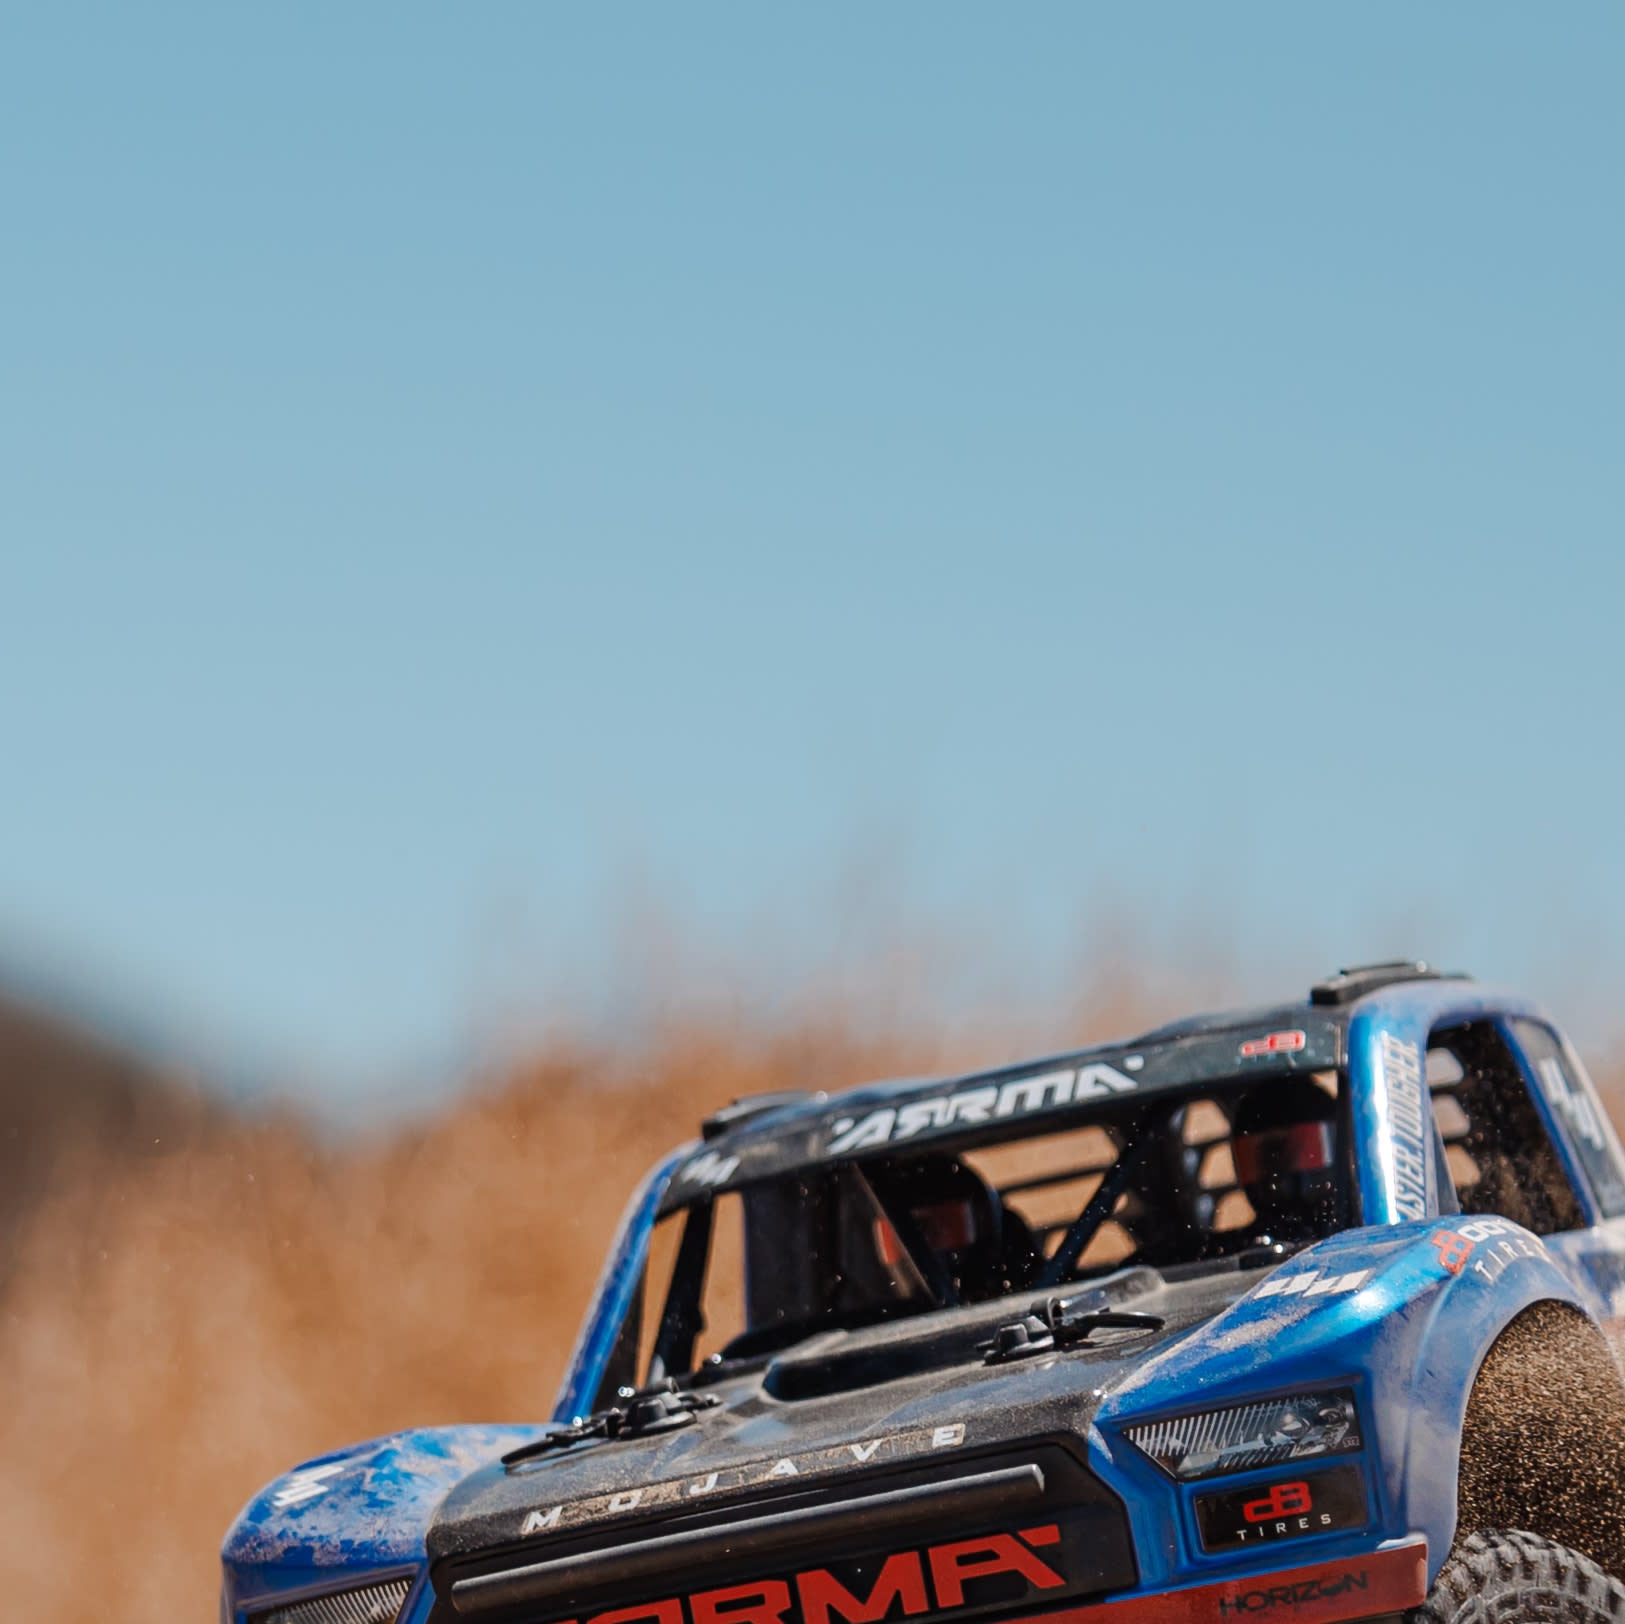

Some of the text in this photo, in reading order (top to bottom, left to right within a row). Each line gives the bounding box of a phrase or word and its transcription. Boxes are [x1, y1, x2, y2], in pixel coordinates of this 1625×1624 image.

[828, 1055, 1145, 1155] ARRMA
[520, 1423, 966, 1534] MOJAVE
[1237, 1513, 1332, 1541] TIRES
[1219, 1570, 1368, 1617] HORIZON
